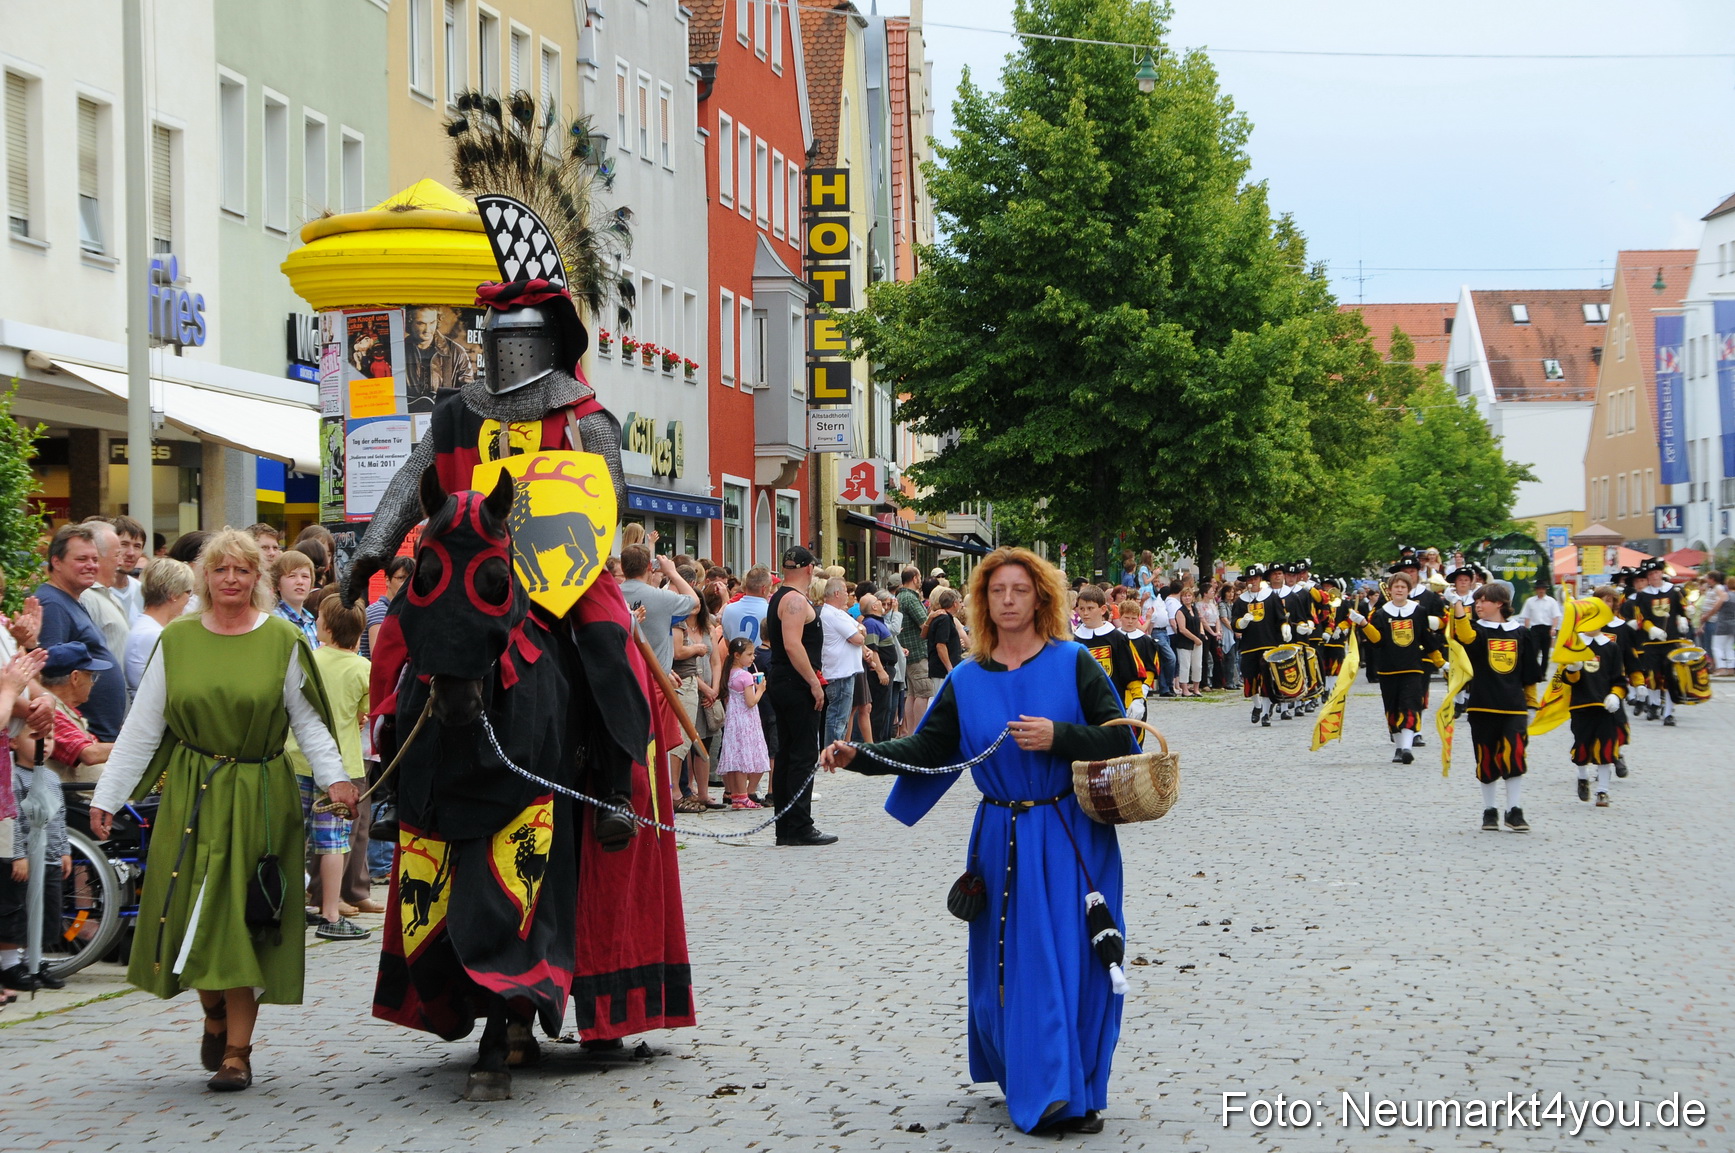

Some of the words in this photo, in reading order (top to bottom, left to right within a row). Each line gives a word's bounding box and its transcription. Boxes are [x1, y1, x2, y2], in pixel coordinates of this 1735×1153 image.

[809, 174, 849, 398] HOTEL
[358, 315, 375, 323] Knopf
[816, 421, 845, 431] Stern
[1494, 548, 1536, 556] Naturgenuss
